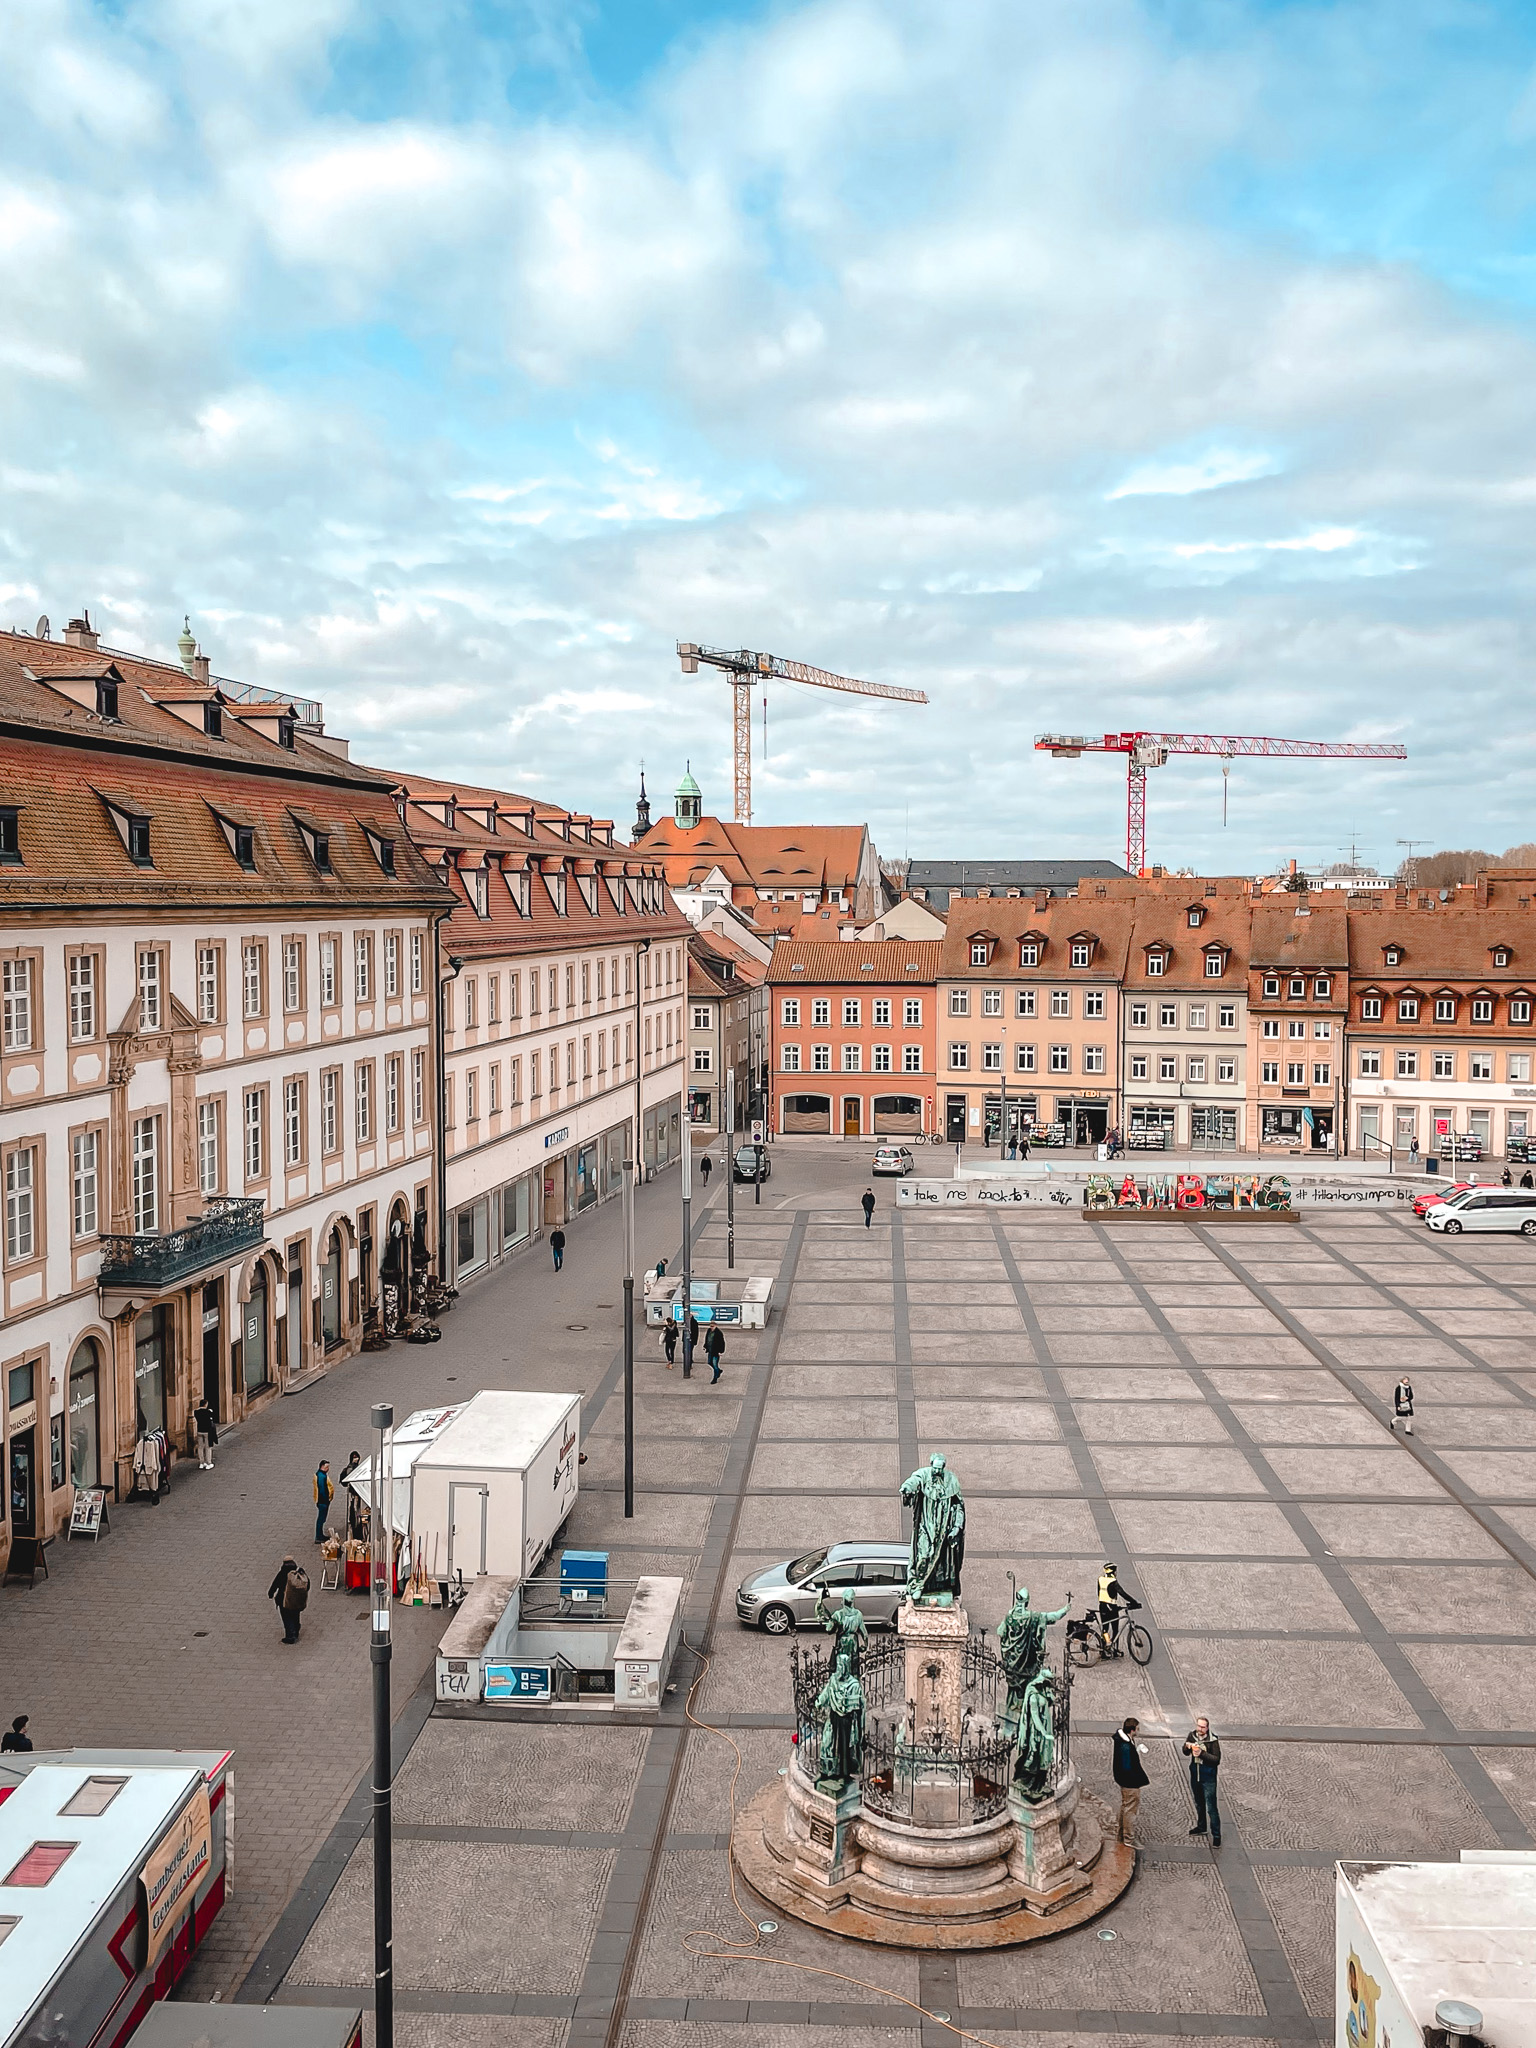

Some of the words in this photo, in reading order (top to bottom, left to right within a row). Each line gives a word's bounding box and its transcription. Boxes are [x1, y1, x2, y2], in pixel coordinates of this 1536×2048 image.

[914, 1188, 940, 1202] take
[946, 1190, 968, 1200] me
[1087, 1174, 1292, 1211] BAMBERG
